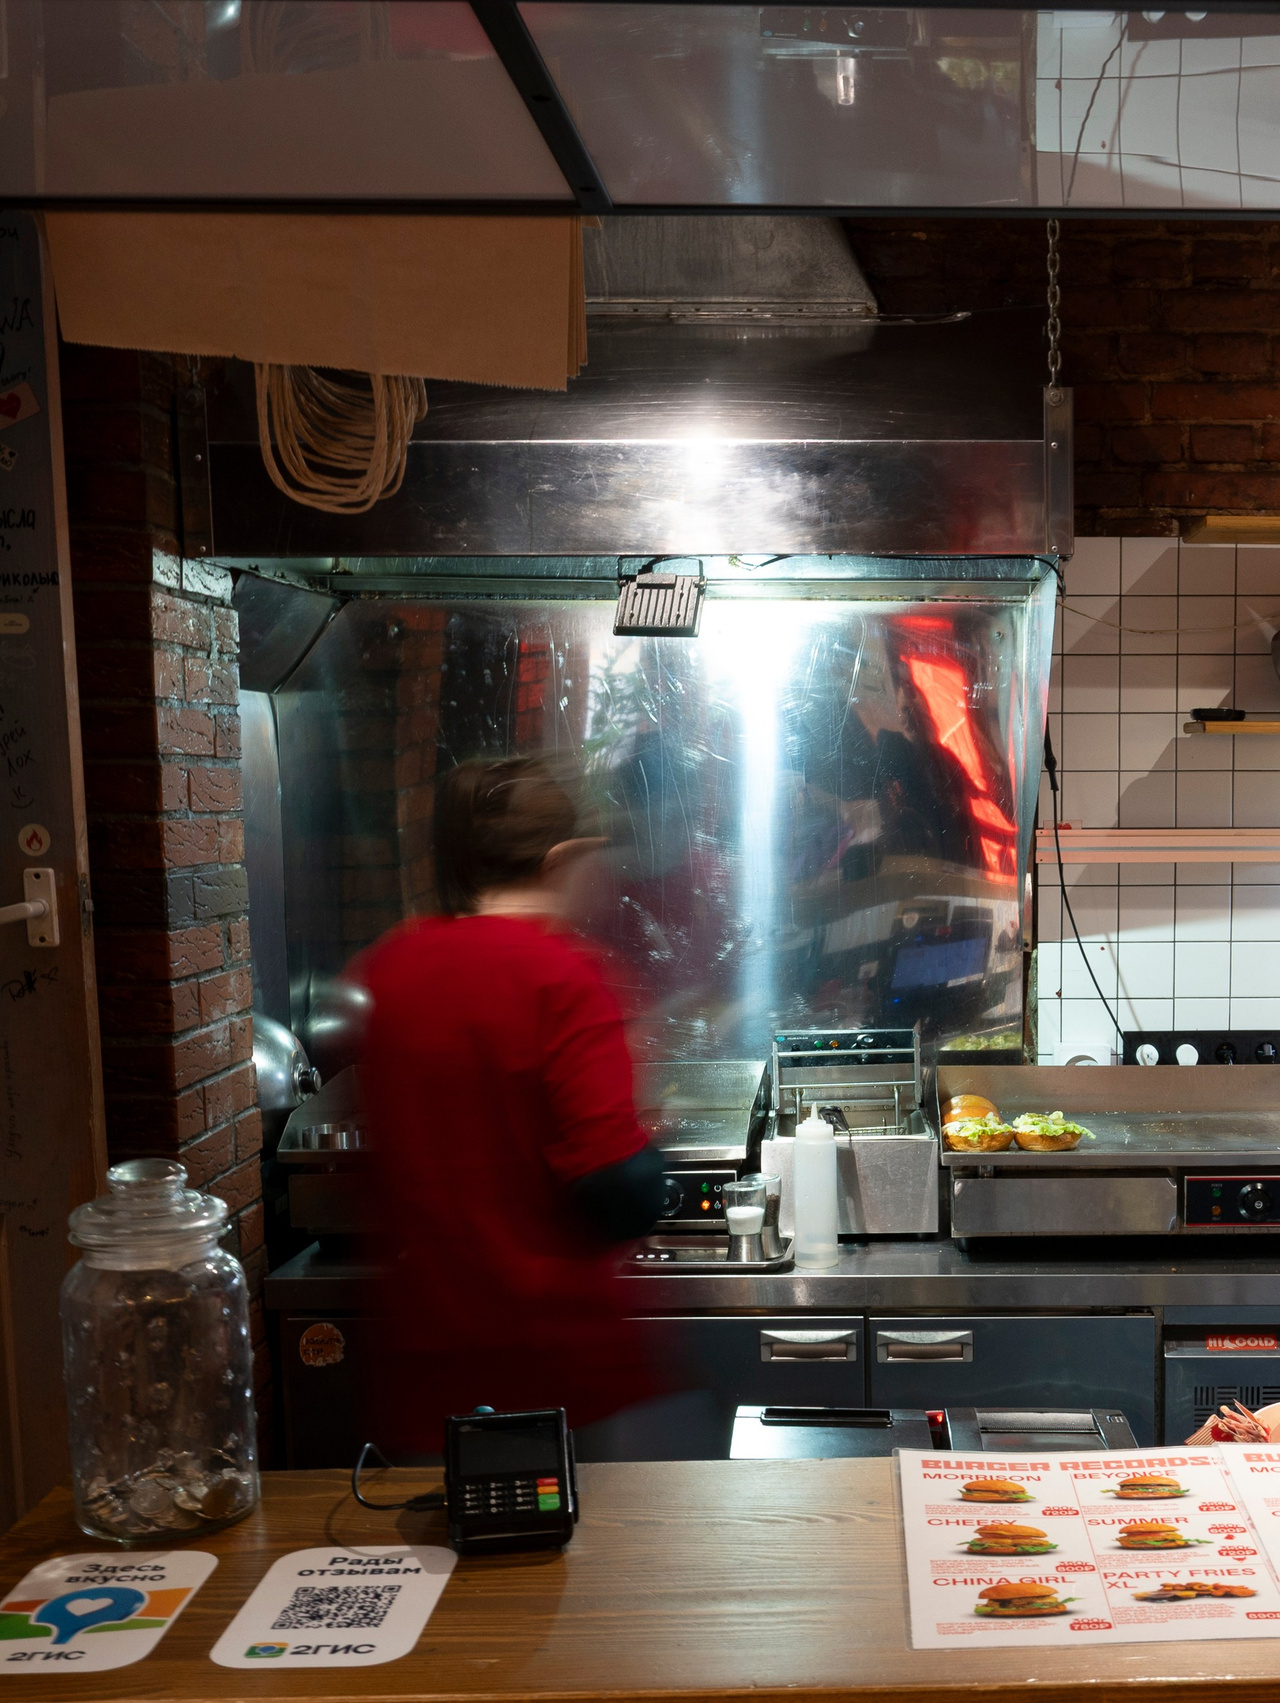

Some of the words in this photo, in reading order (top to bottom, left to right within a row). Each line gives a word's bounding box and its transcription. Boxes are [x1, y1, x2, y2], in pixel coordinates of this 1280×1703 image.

[1235, 1336, 1275, 1347] COLD
[921, 1459, 1051, 1472] BURGER
[1059, 1456, 1212, 1471] RECORDS
[923, 1473, 1042, 1482] MORRISON
[1073, 1470, 1179, 1480] BEYONCE
[927, 1518, 1017, 1527] CHEESY
[1088, 1517, 1189, 1526] SUMMER
[328, 1556, 404, 1568] Рады
[82, 1562, 165, 1577] Здесь
[297, 1565, 422, 1577] отзывам
[1103, 1570, 1182, 1580] PARTY
[1188, 1568, 1256, 1577] FRIES
[65, 1574, 166, 1585] вкусно
[933, 1577, 1008, 1586] CHINA
[1019, 1576, 1076, 1585] GIRL
[1107, 1581, 1138, 1589] XL
[290, 1643, 377, 1656] 2ГИС
[5, 1650, 87, 1662] 2ГИС
